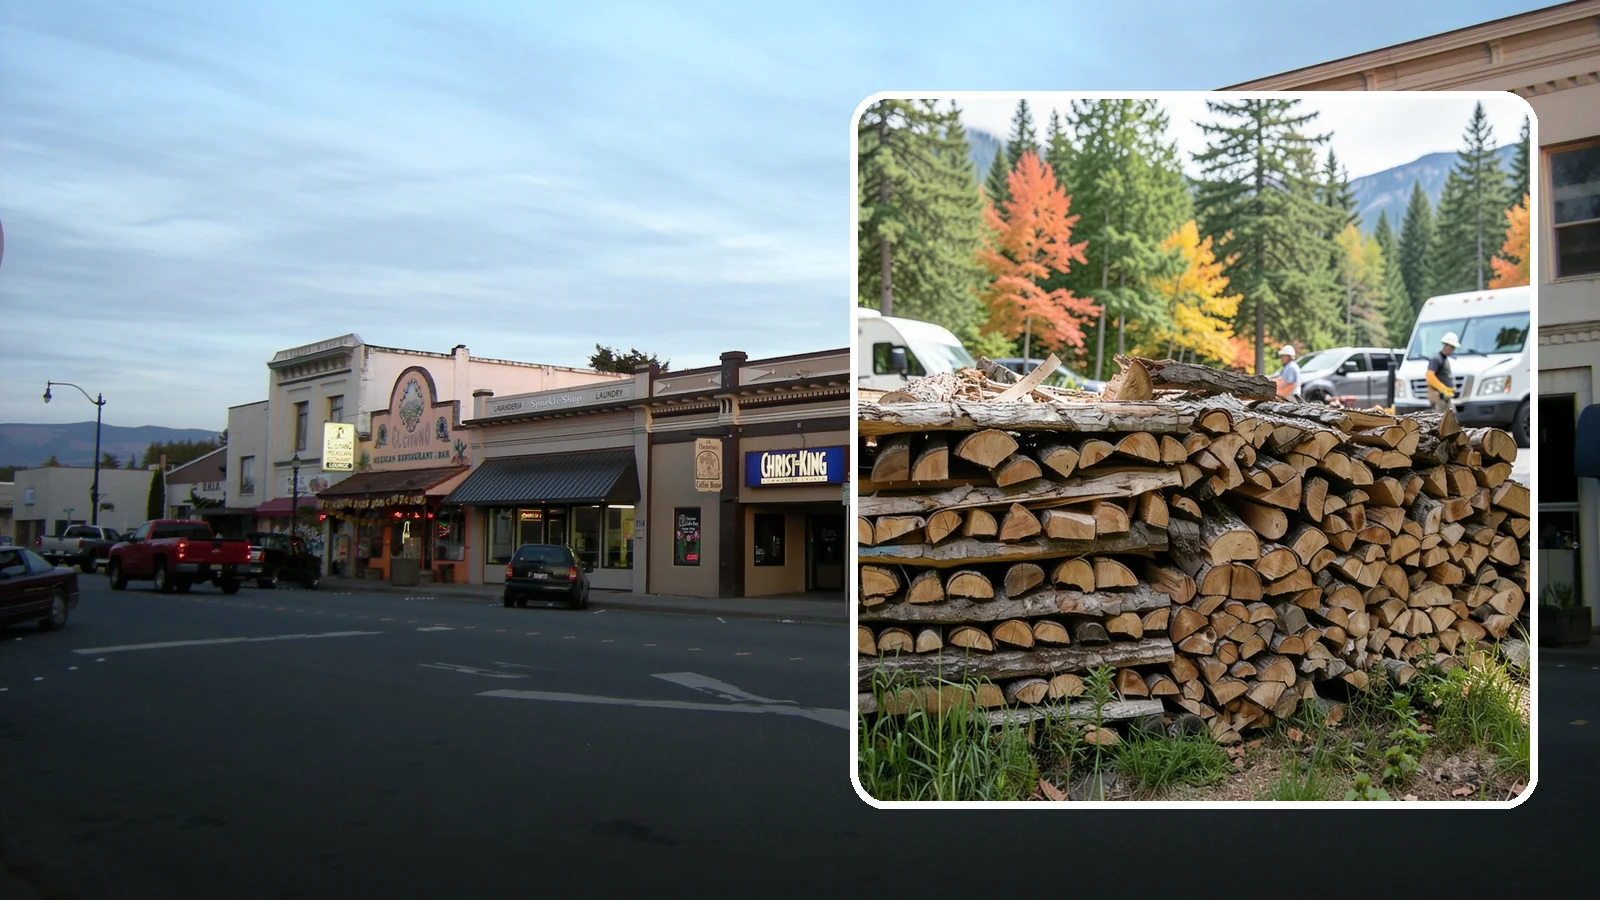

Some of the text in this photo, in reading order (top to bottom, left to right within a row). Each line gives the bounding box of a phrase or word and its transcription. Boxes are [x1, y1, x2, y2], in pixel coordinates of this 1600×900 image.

[530, 394, 582, 408] Sparkle Shop
[595, 388, 624, 400] LAUNDRY
[494, 402, 523, 412] LAVANDERIA
[374, 455, 396, 464] MEXICAN
[398, 452, 433, 462] RESTAURANT
[438, 450, 450, 459] BAR
[760, 450, 827, 478] CHRIST KING
